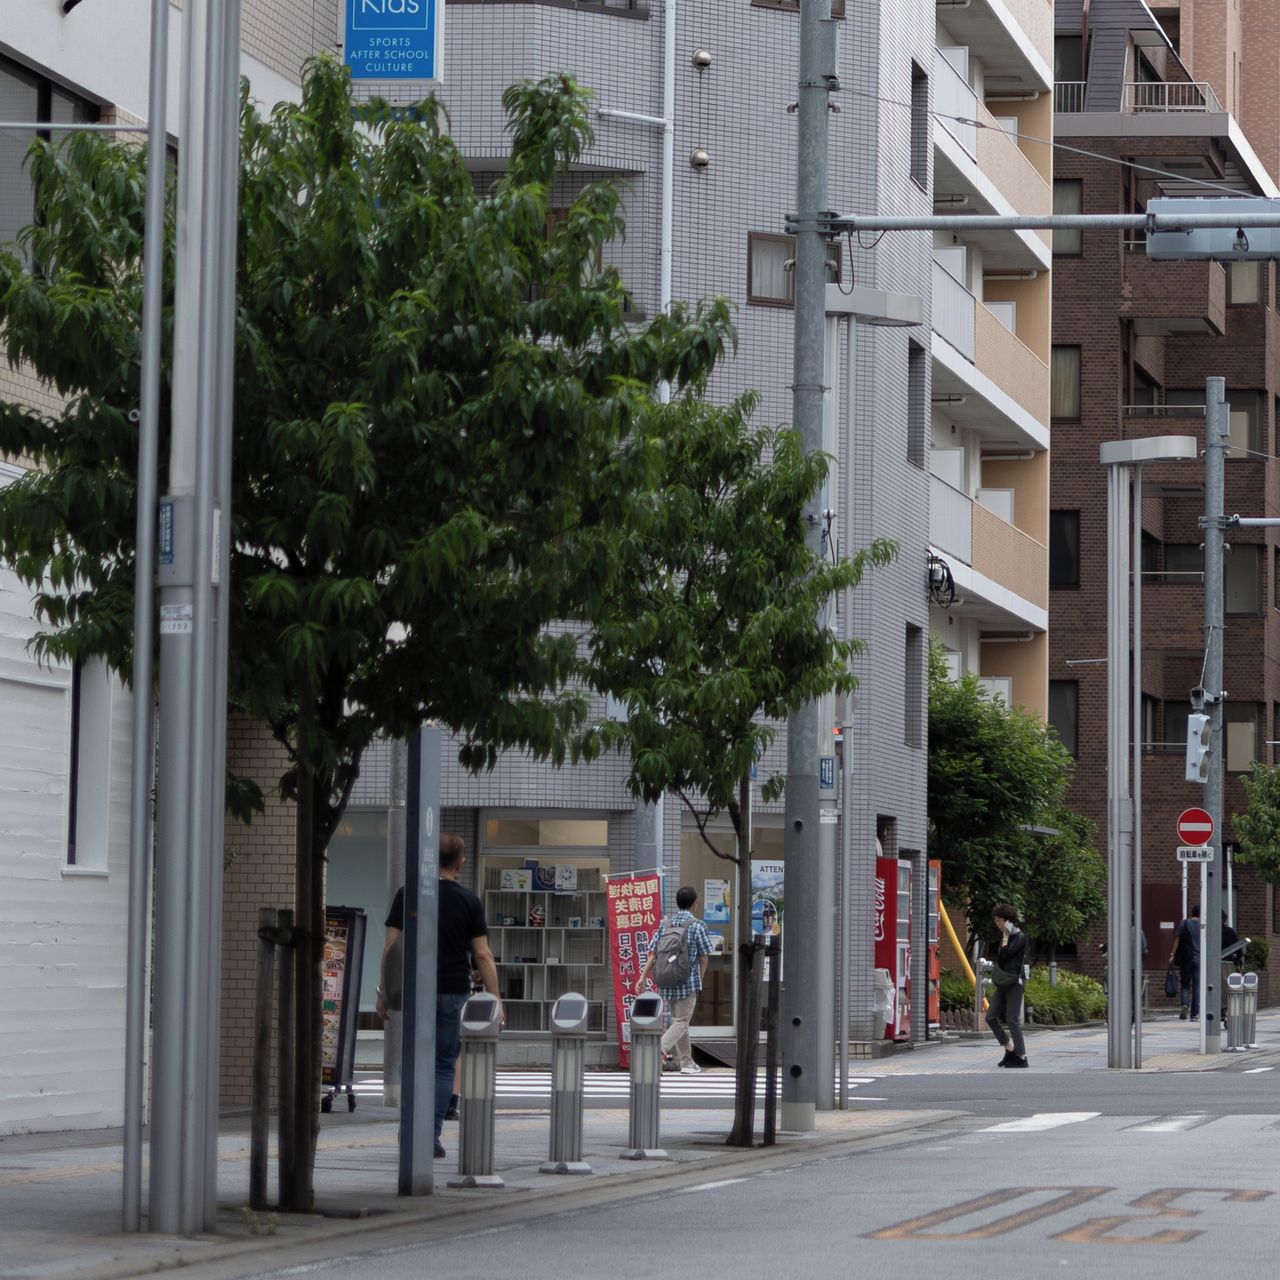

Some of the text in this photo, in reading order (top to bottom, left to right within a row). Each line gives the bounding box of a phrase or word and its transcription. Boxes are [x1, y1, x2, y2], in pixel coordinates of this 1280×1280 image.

[369, 38, 411, 47] SPORTS
[350, 50, 429, 59] AFTER SCHOOL
[365, 62, 413, 72] CULTURE
